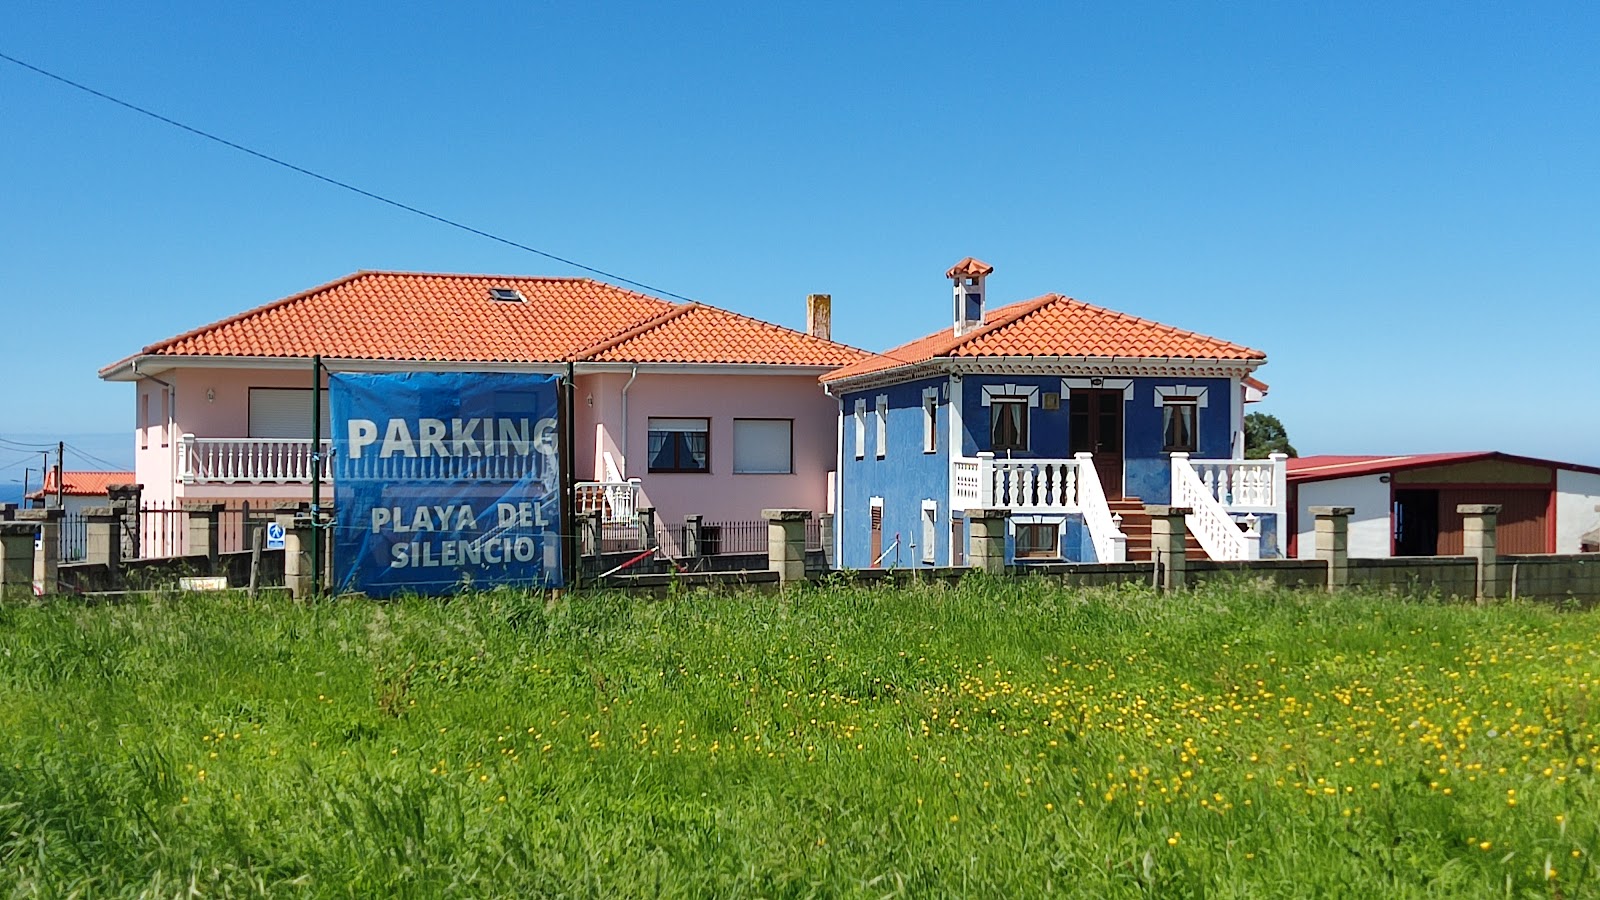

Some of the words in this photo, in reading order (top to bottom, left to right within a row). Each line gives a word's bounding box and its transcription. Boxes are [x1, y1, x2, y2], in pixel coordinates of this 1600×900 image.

[347, 418, 558, 459] PARKING
[371, 504, 477, 534] PLAYA
[497, 502, 549, 529] DEL
[390, 536, 535, 568] SILENCIO
